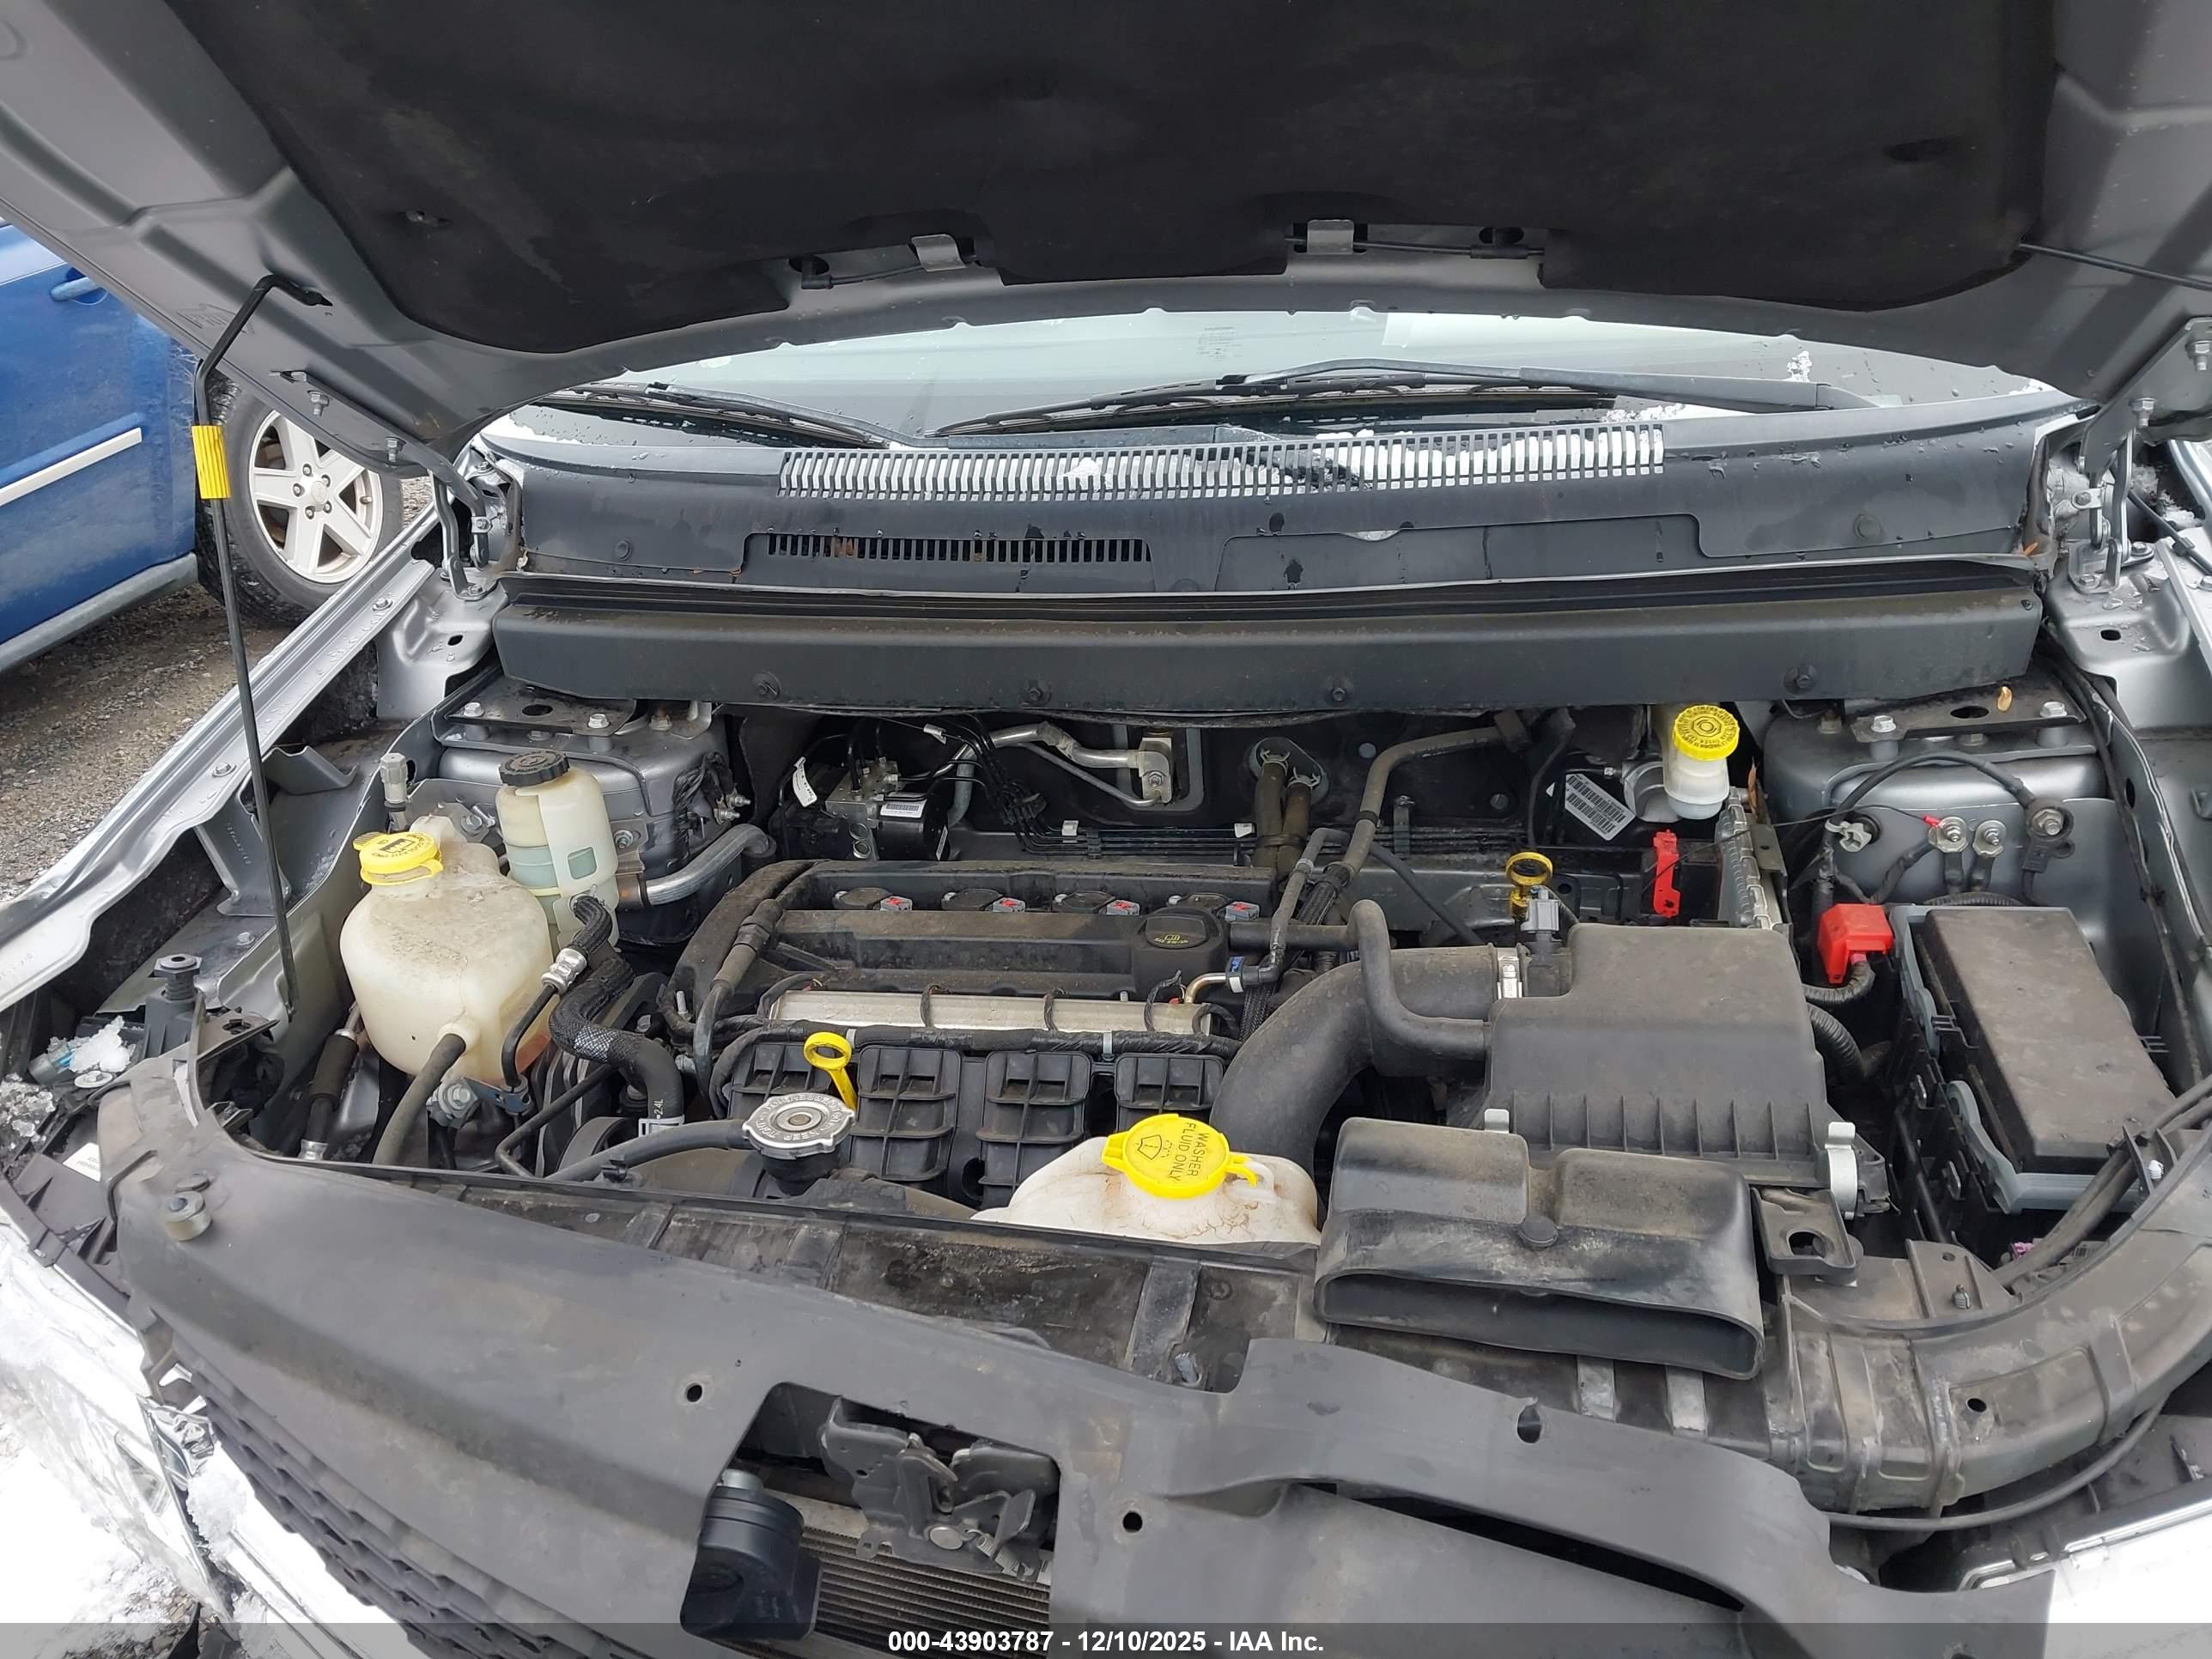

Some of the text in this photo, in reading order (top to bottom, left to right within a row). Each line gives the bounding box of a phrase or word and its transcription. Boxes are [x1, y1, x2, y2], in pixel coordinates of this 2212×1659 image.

[653, 1099, 665, 1116] 2.4L
[1168, 1122, 1196, 1181] FLUID ONLY
[1187, 1133, 1209, 1176] WASHER
